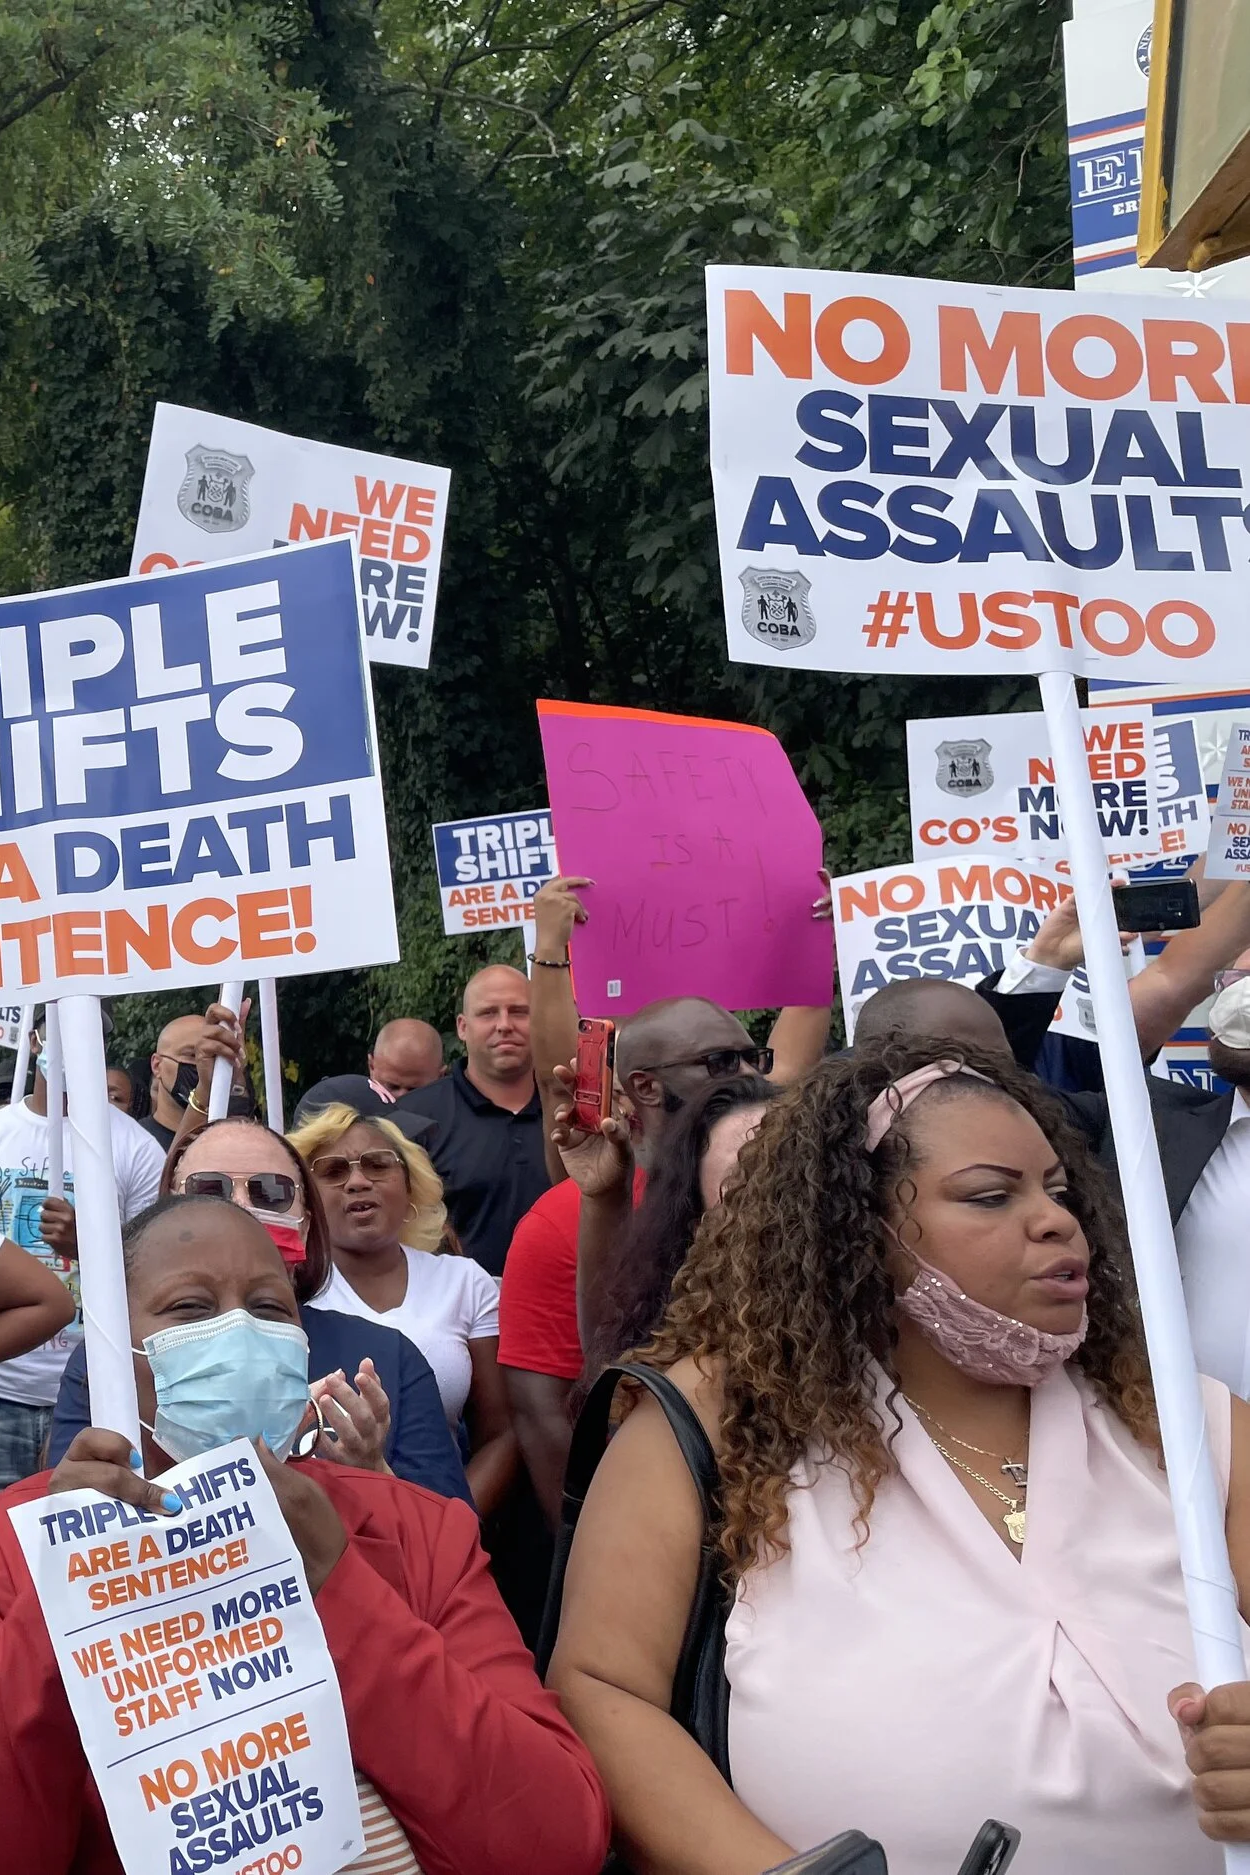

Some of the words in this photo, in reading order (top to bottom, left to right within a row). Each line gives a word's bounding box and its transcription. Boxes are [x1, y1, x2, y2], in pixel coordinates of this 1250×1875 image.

[723, 289, 911, 386] NO
[794, 388, 1243, 489] SEXUAL
[354, 474, 437, 527] WE
[359, 558, 427, 603] RE
[363, 598, 422, 643] W!
[757, 621, 802, 637] COBA
[861, 590, 1217, 660] #USTOO
[1082, 721, 1145, 752] WE
[566, 742, 769, 819] SAFETY
[1028, 752, 1146, 785] NED
[1018, 780, 1148, 813] MRE
[55, 793, 356, 896] DEATH
[452, 818, 556, 854] TRIPL
[649, 833, 692, 865] IS
[711, 825, 735, 861] A
[919, 816, 1018, 846] CO'S
[1030, 809, 1149, 840] NW!
[1227, 823, 1246, 836] NO
[1232, 836, 1250, 848] SEX
[454, 845, 560, 882] SHIFT
[448, 885, 495, 907] ARE
[500, 883, 519, 901] A
[462, 903, 536, 927] SENTE
[838, 874, 925, 923] NO
[874, 905, 1047, 952] SEXUA
[173, 1457, 257, 1510] HIFTS
[67, 1541, 131, 1583] ARE
[137, 1534, 163, 1564] A
[166, 1501, 256, 1557] DEATH
[87, 1538, 249, 1612] SENTENCE!
[71, 1638, 118, 1679] WE
[119, 1610, 205, 1660] NEED
[211, 1576, 302, 1631] MORE
[101, 1617, 285, 1704] UNIFORMED
[113, 1678, 203, 1737] STAFF
[207, 1645, 294, 1701] NOW!
[138, 1758, 198, 1812] NO
[201, 1711, 311, 1786] MORE
[170, 1761, 300, 1838] SEXUAL
[169, 1787, 324, 1875] ASSAULTS
